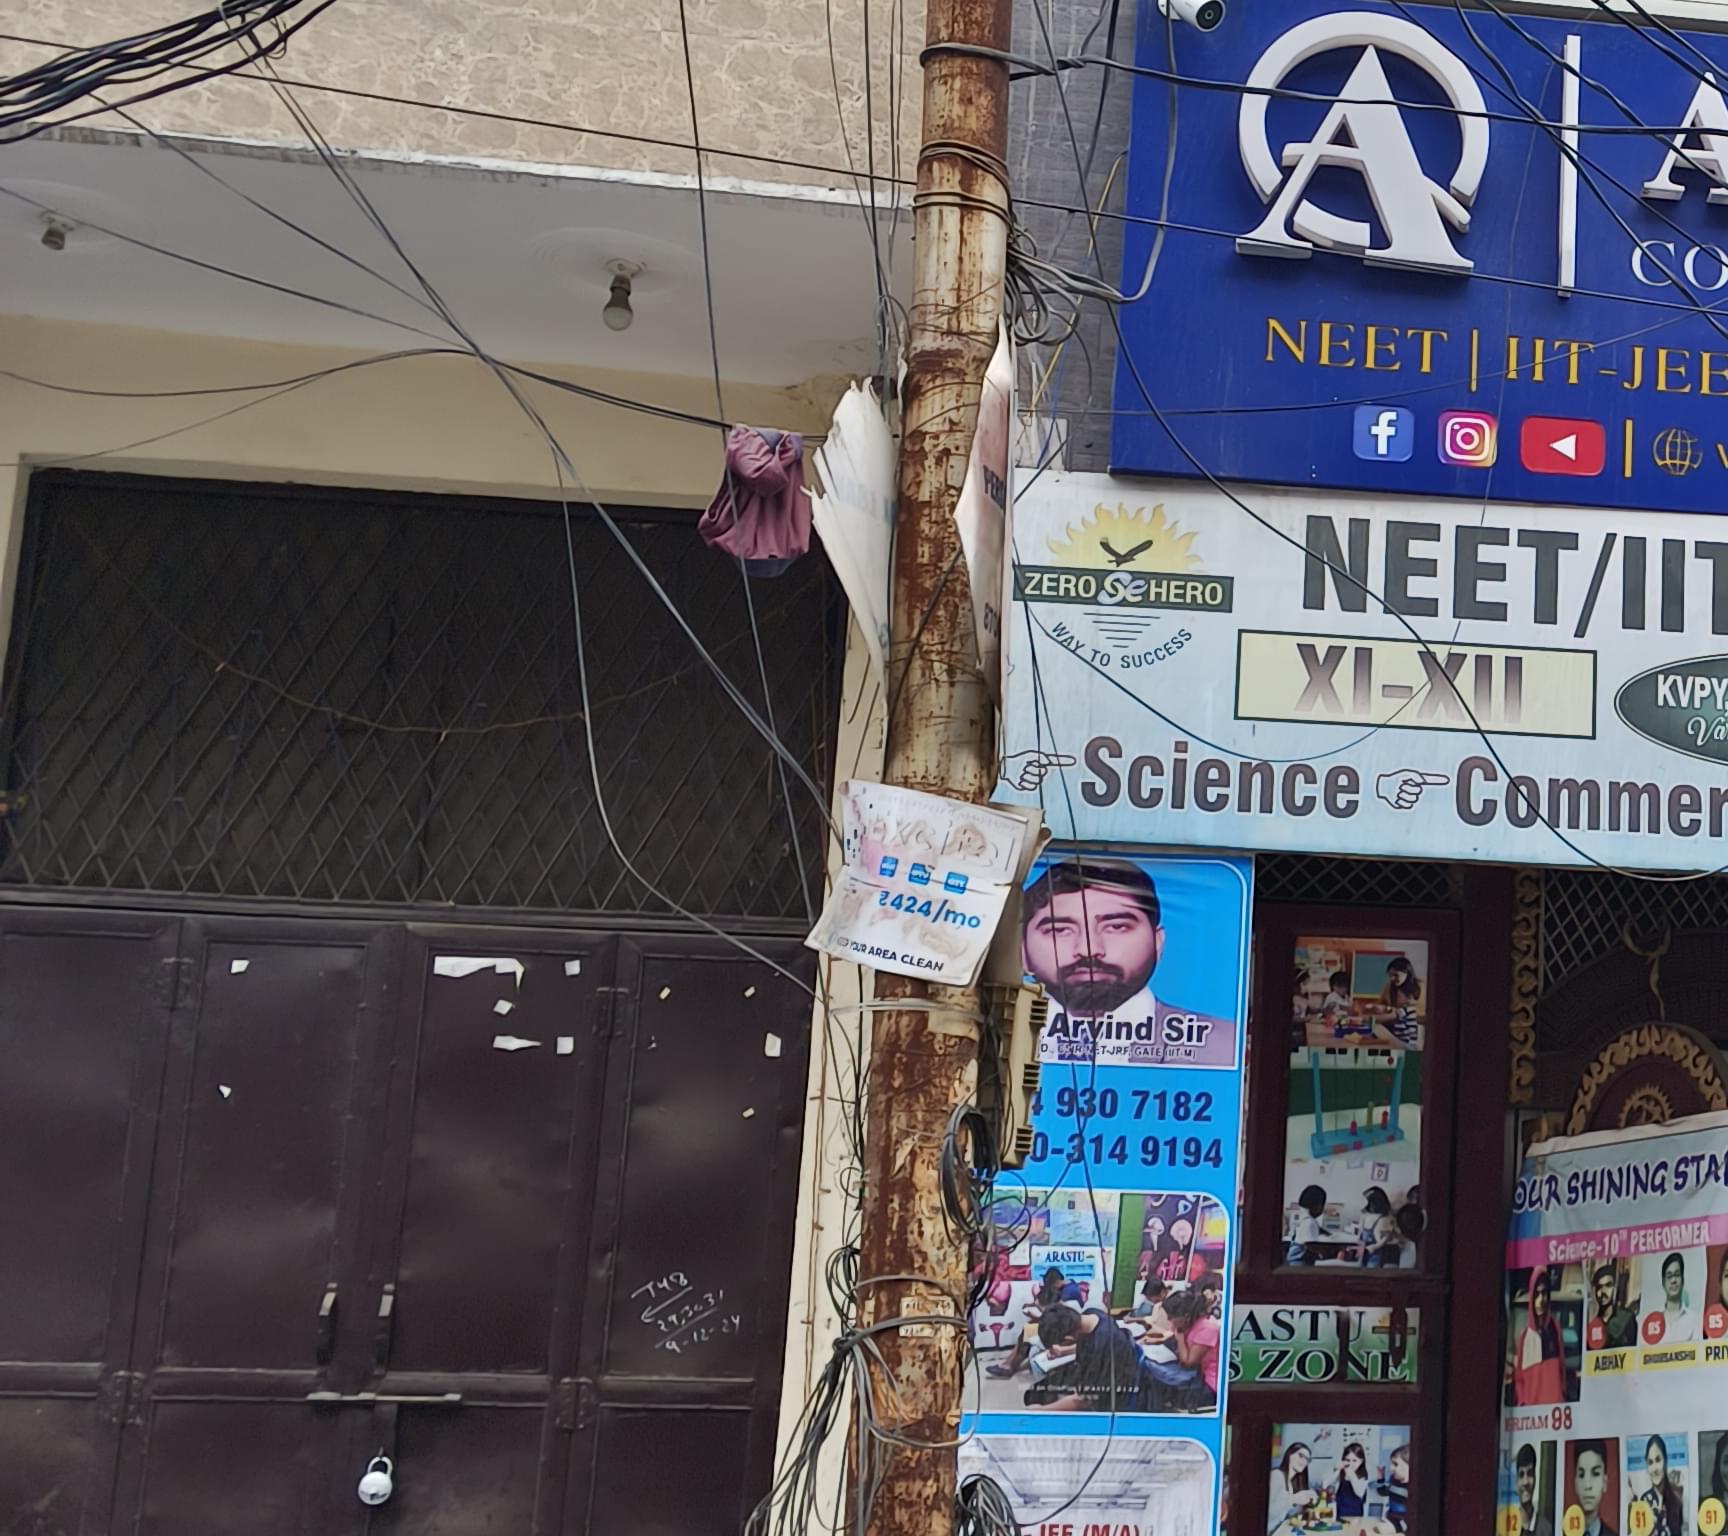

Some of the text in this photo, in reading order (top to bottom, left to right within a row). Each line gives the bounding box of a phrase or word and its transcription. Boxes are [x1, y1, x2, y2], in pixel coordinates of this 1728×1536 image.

[1264, 316, 1449, 374] NEET
[1023, 571, 1223, 606] ZERO HERO
[1051, 621, 1194, 669] WAY TO SUCCESS
[1295, 642, 1523, 725] XI-XII
[1080, 735, 1360, 820] Science
[867, 945, 945, 973] AREA CLEAN
[1047, 1012, 1210, 1045] Arvind Sir
[1056, 1086, 1119, 1119] 930
[1131, 1088, 1214, 1123] 7182
[1140, 1135, 1224, 1169] 9194
[1513, 1174, 1561, 1213] OUR
[1566, 1161, 1669, 1206] SHINING
[1630, 1221, 1711, 1254] PERFORMER
[1255, 1348, 1410, 1383] ZONE
